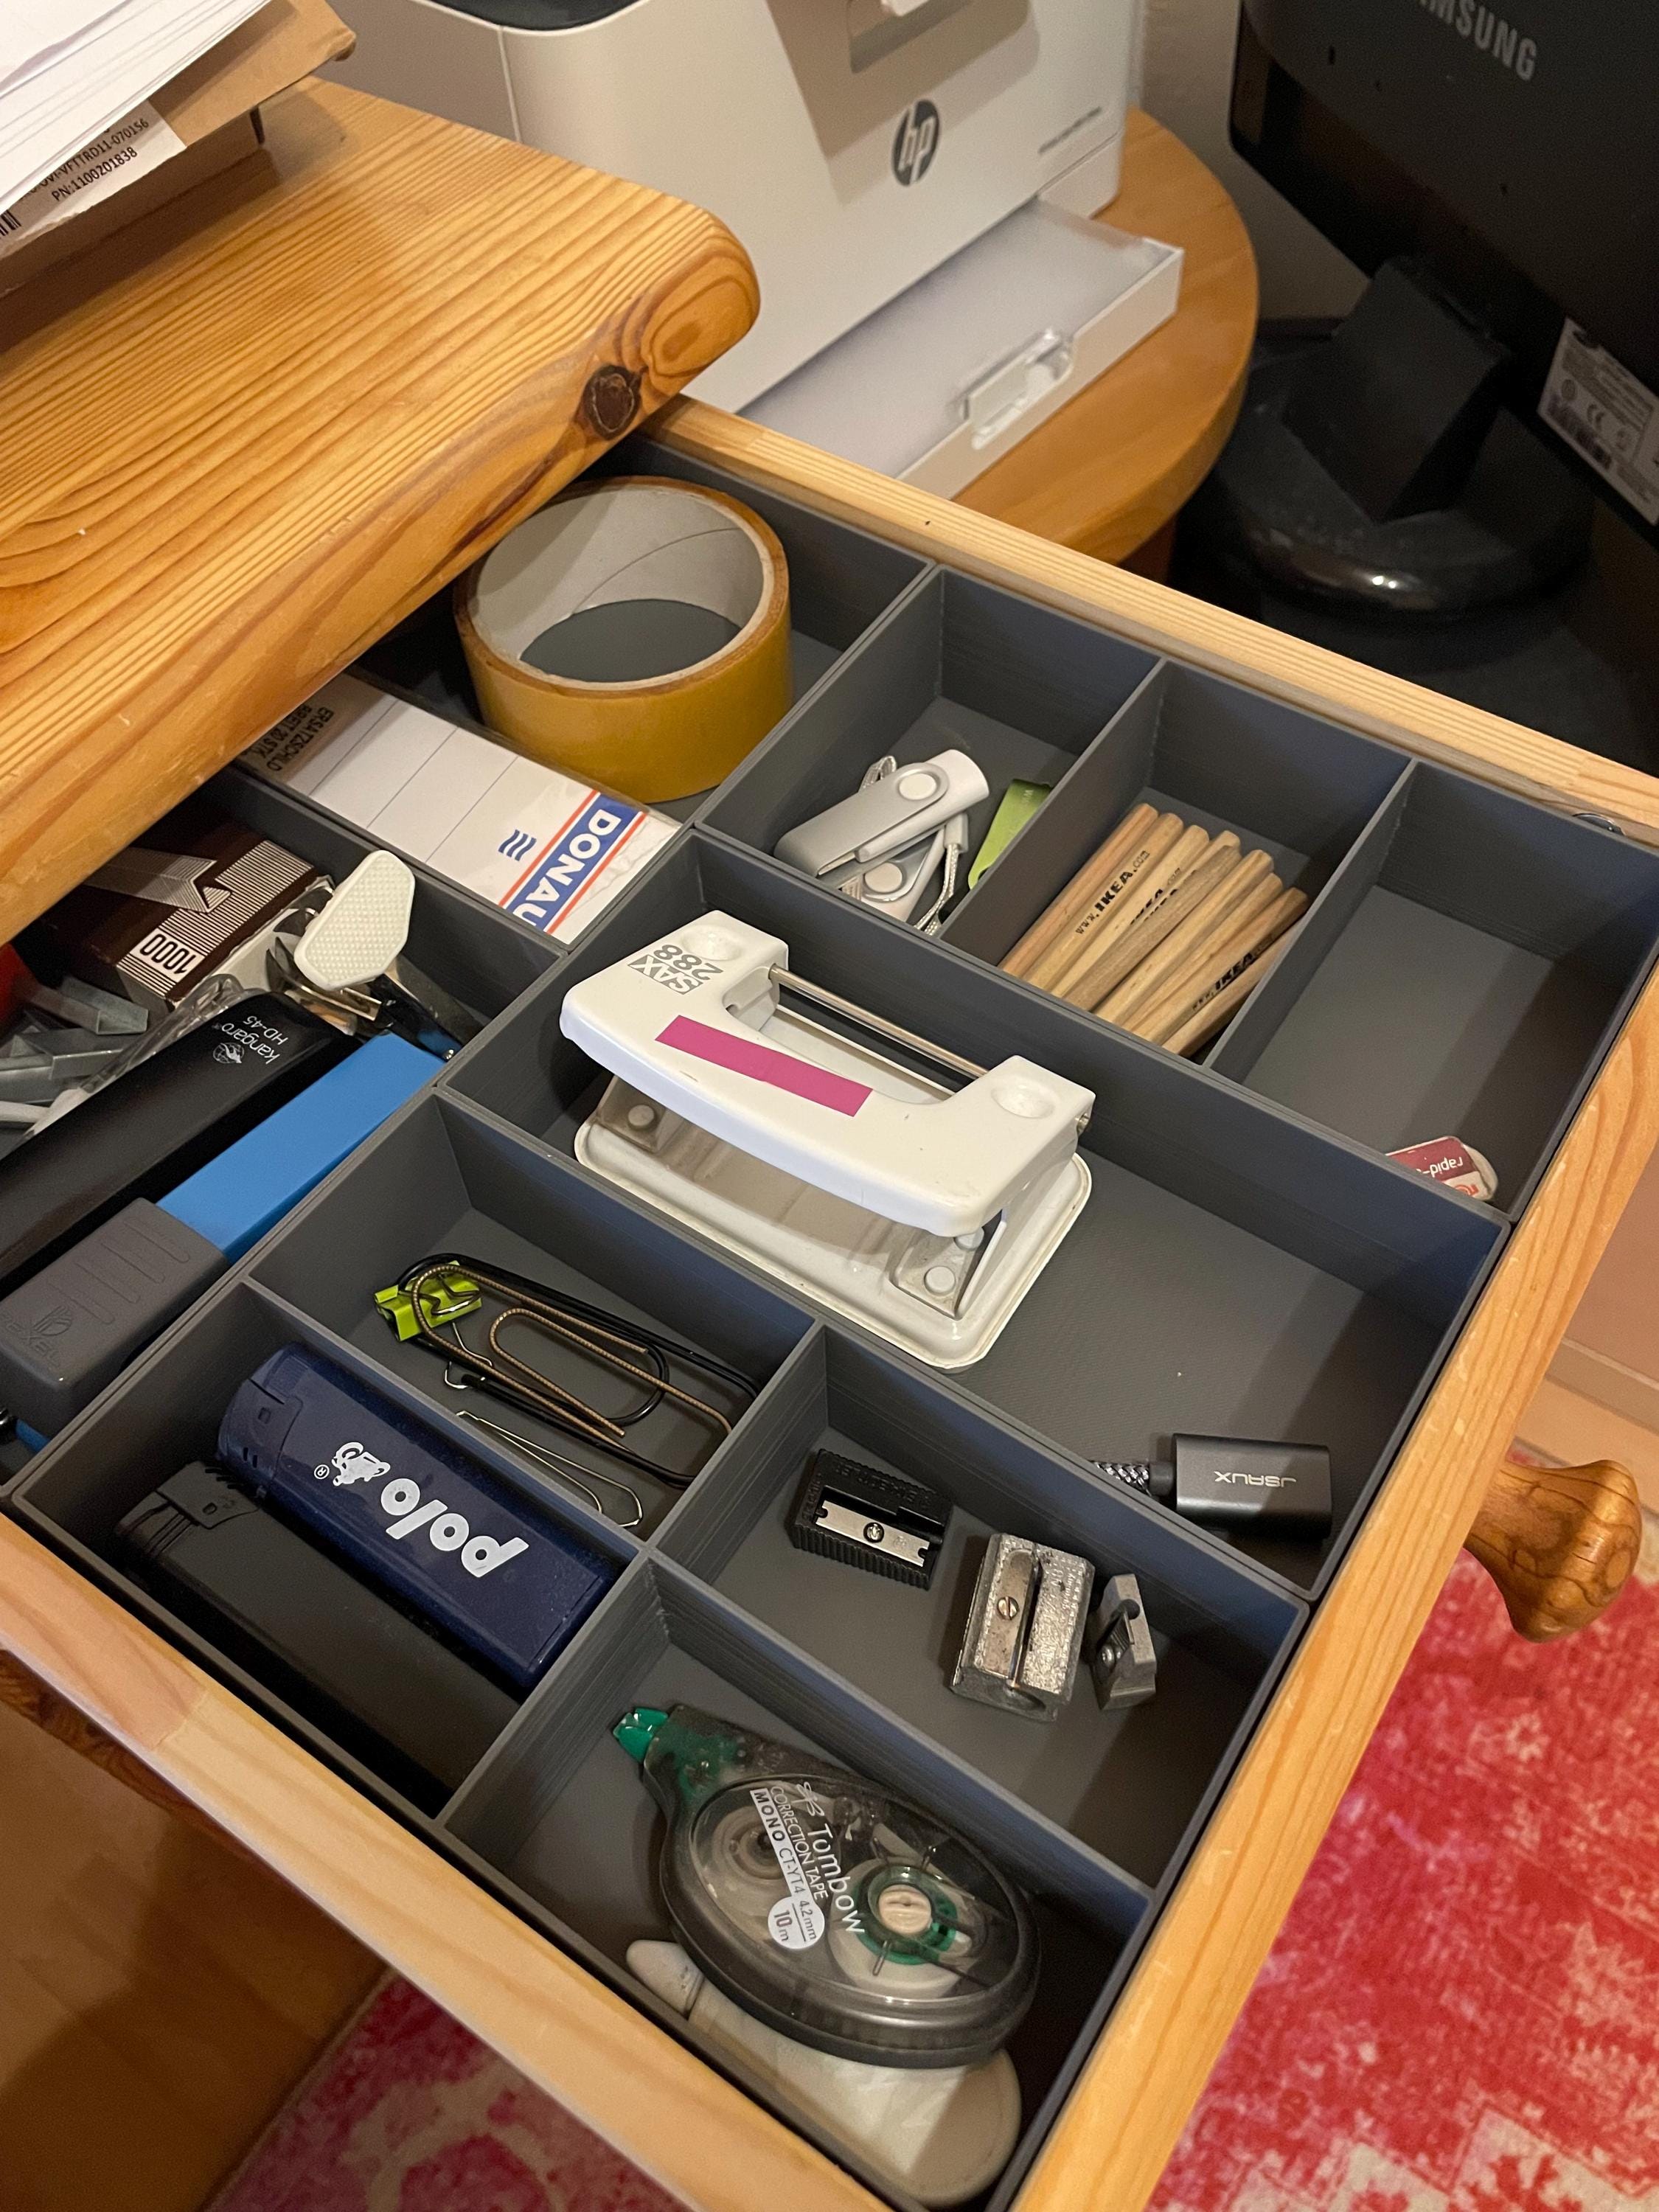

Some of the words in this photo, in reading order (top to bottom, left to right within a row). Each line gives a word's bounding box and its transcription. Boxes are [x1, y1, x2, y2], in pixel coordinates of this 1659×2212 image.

[1420, 0, 1537, 81] MSUNG
[892, 99, 939, 186] hp
[51, 146, 138, 201] PN:1100201838
[250, 737, 278, 759] STK
[266, 706, 334, 771] ERSATZSCHILD
[512, 808, 622, 927] DONAU
[1074, 850, 1150, 935] www.IKEA.com
[139, 933, 196, 974] 1000
[627, 955, 703, 994] SAX
[653, 944, 724, 981] 288
[221, 1023, 280, 1064] kangaro
[242, 1015, 288, 1045] HD-45
[1416, 1156, 1464, 1178] rapid-
[1213, 1470, 1297, 1488] JSAUX
[380, 1478, 529, 1578] polo
[754, 1791, 786, 1842] MONO
[778, 1848, 806, 1894] CT-YT4
[770, 1786, 815, 1865] CORRECTION
[804, 1865, 830, 1901] TAPE
[807, 1823, 866, 1933] Tombow
